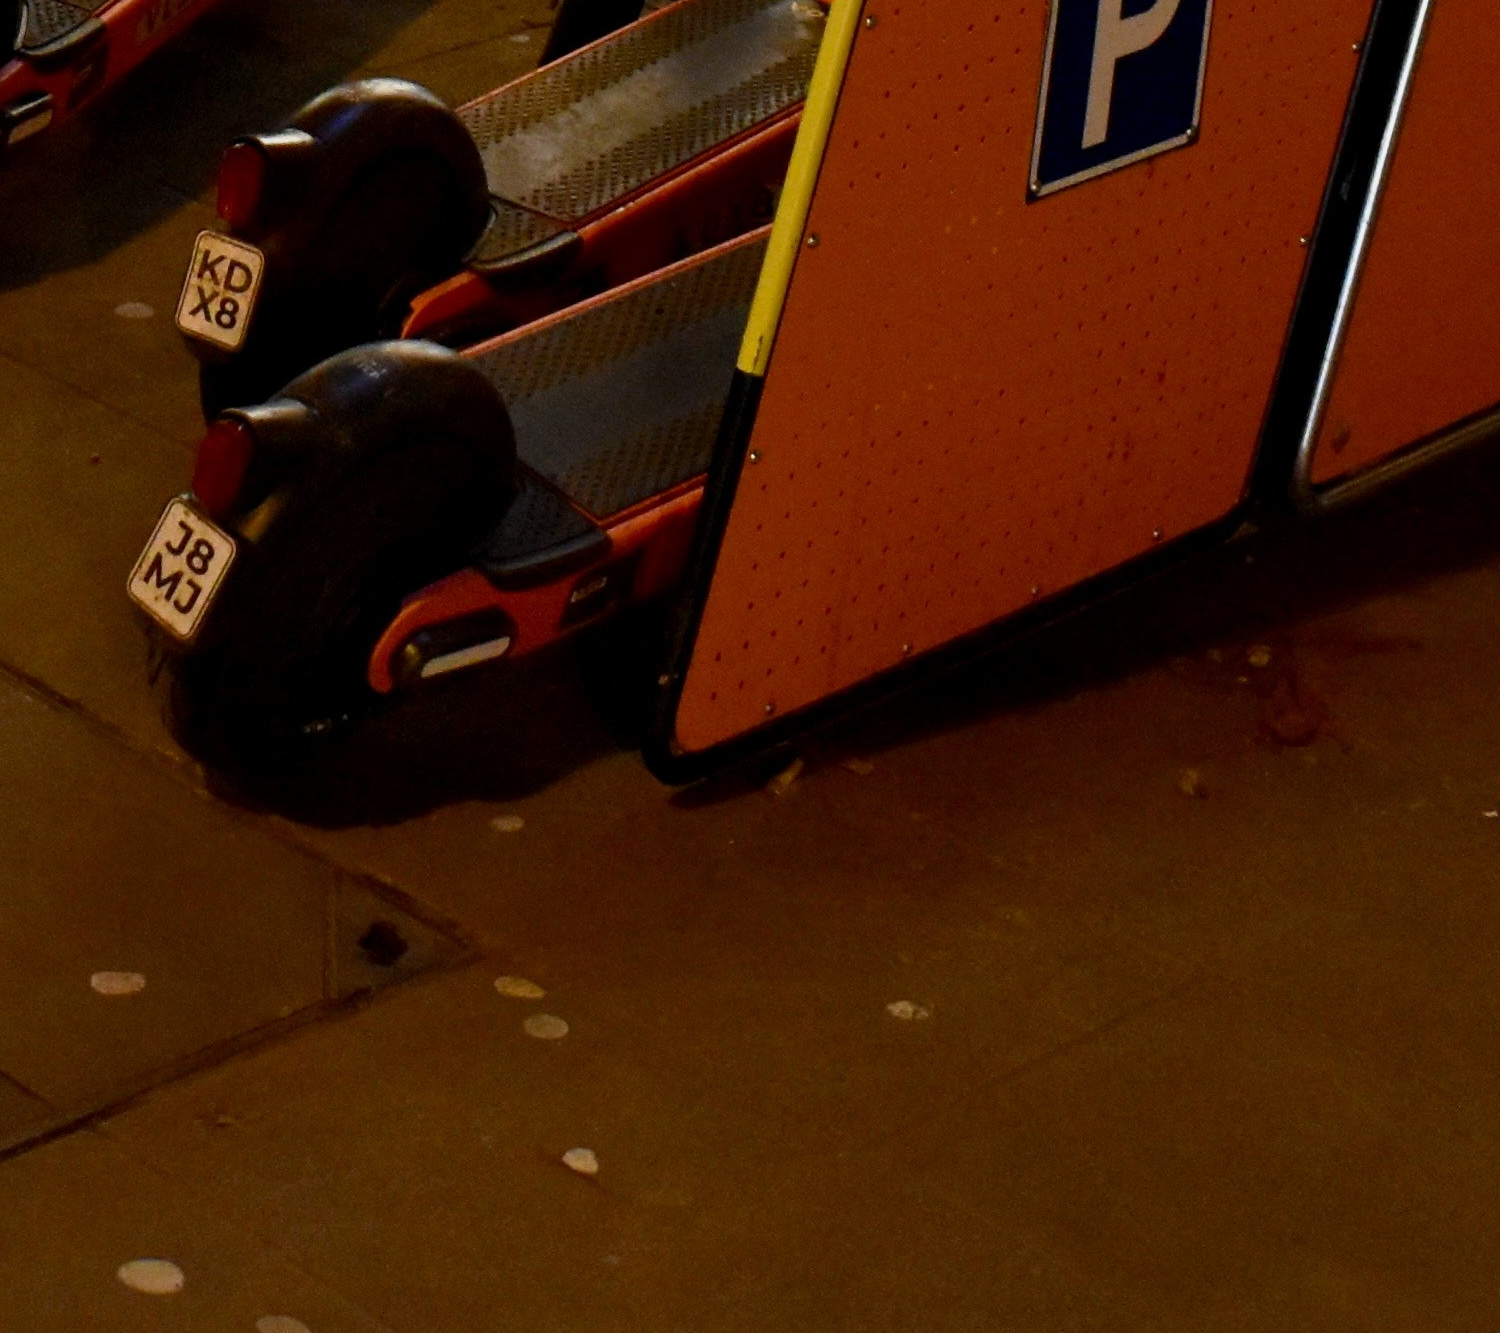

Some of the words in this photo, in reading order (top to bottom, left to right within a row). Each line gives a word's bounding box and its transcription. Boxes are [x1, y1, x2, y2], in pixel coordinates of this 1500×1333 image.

[197, 249, 253, 293] KD
[189, 286, 240, 329] X8
[165, 520, 214, 575] J8
[143, 551, 202, 614] MJ
